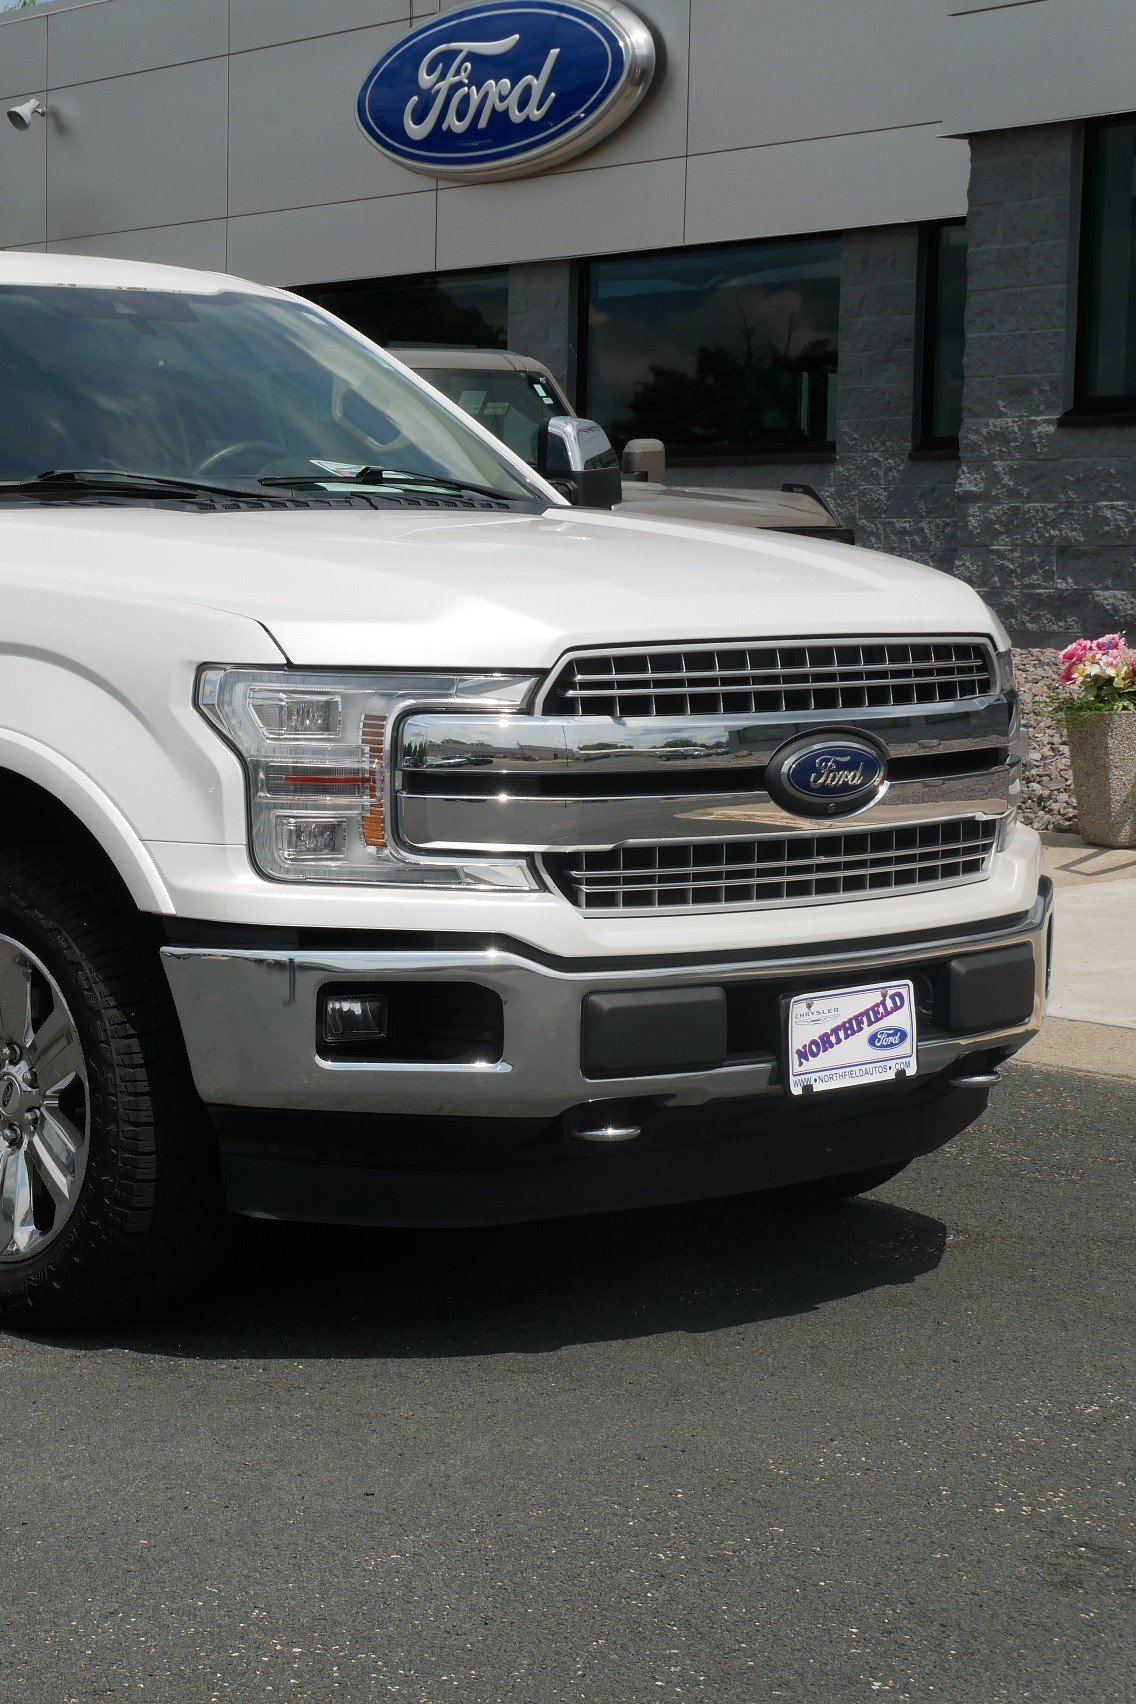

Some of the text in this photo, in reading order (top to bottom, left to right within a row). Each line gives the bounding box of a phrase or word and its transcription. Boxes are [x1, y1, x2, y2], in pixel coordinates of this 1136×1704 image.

[403, 34, 561, 140] Ford
[810, 755, 864, 789] Ford
[795, 1007, 840, 1020] CHRYSLER
[795, 991, 905, 1067] NORTHFIELD
[874, 1029, 901, 1047] Ford
